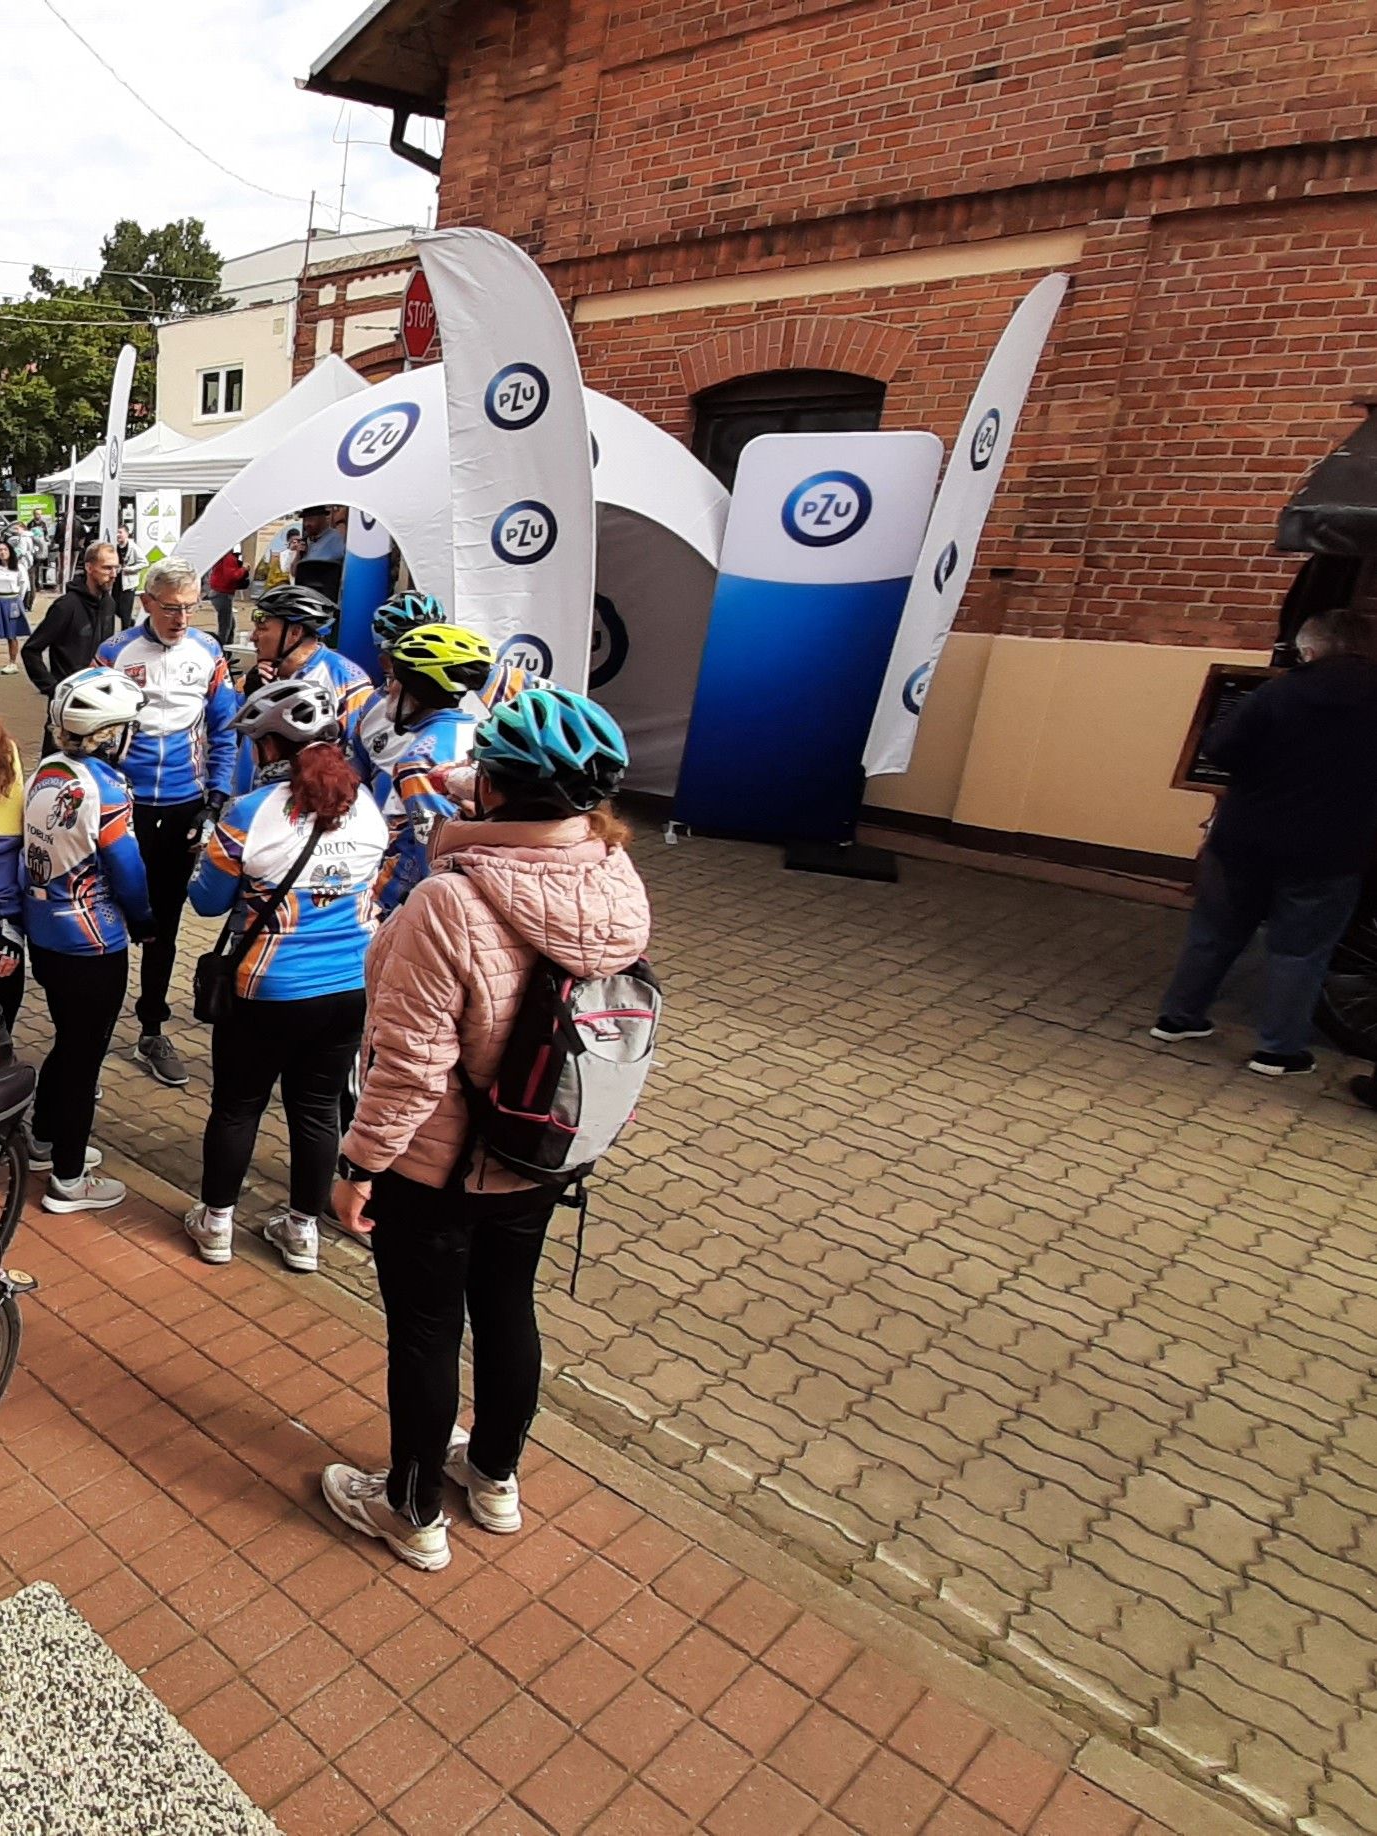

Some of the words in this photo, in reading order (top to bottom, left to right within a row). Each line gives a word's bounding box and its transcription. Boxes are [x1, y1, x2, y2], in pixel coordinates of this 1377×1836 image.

[406, 301, 436, 329] STOP
[498, 381, 536, 412] PZU
[356, 422, 400, 454] PZU
[801, 493, 853, 525] PZU
[505, 519, 544, 547] PZU
[503, 651, 539, 672] PZU
